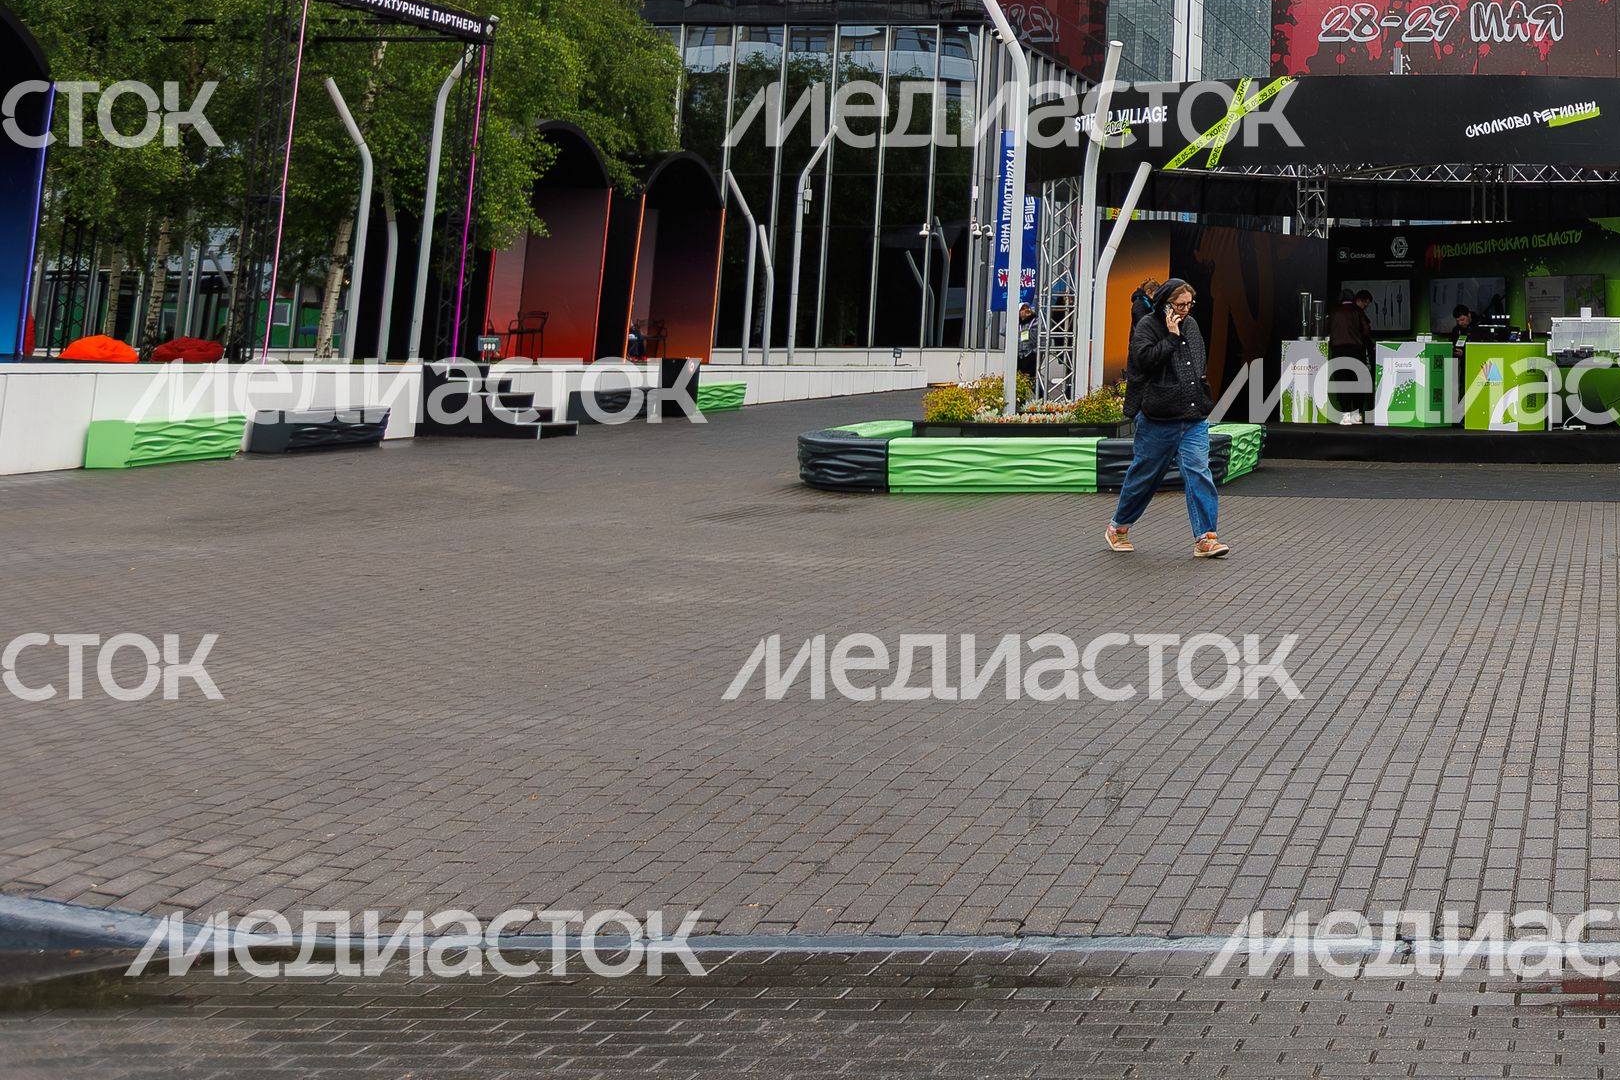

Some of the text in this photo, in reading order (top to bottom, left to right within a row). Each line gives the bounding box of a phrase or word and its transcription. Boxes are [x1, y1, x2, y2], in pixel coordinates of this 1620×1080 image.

[432, 10, 481, 34] ПАРТНЕРЫ
[1318, 1, 1564, 42] 28-29 МАЯ
[1103, 120, 1127, 137] 2026
[1117, 105, 1168, 125] VILLAGE
[1465, 101, 1596, 137] СКОЛКОВО РЕГИОНЫ
[1002, 159, 1014, 221] ПИЛОТНЫХ
[1000, 224, 1011, 253] ЗОНА
[1432, 229, 1583, 259] НОВОСИБИРСКАЯ ОБЛАСТЬ
